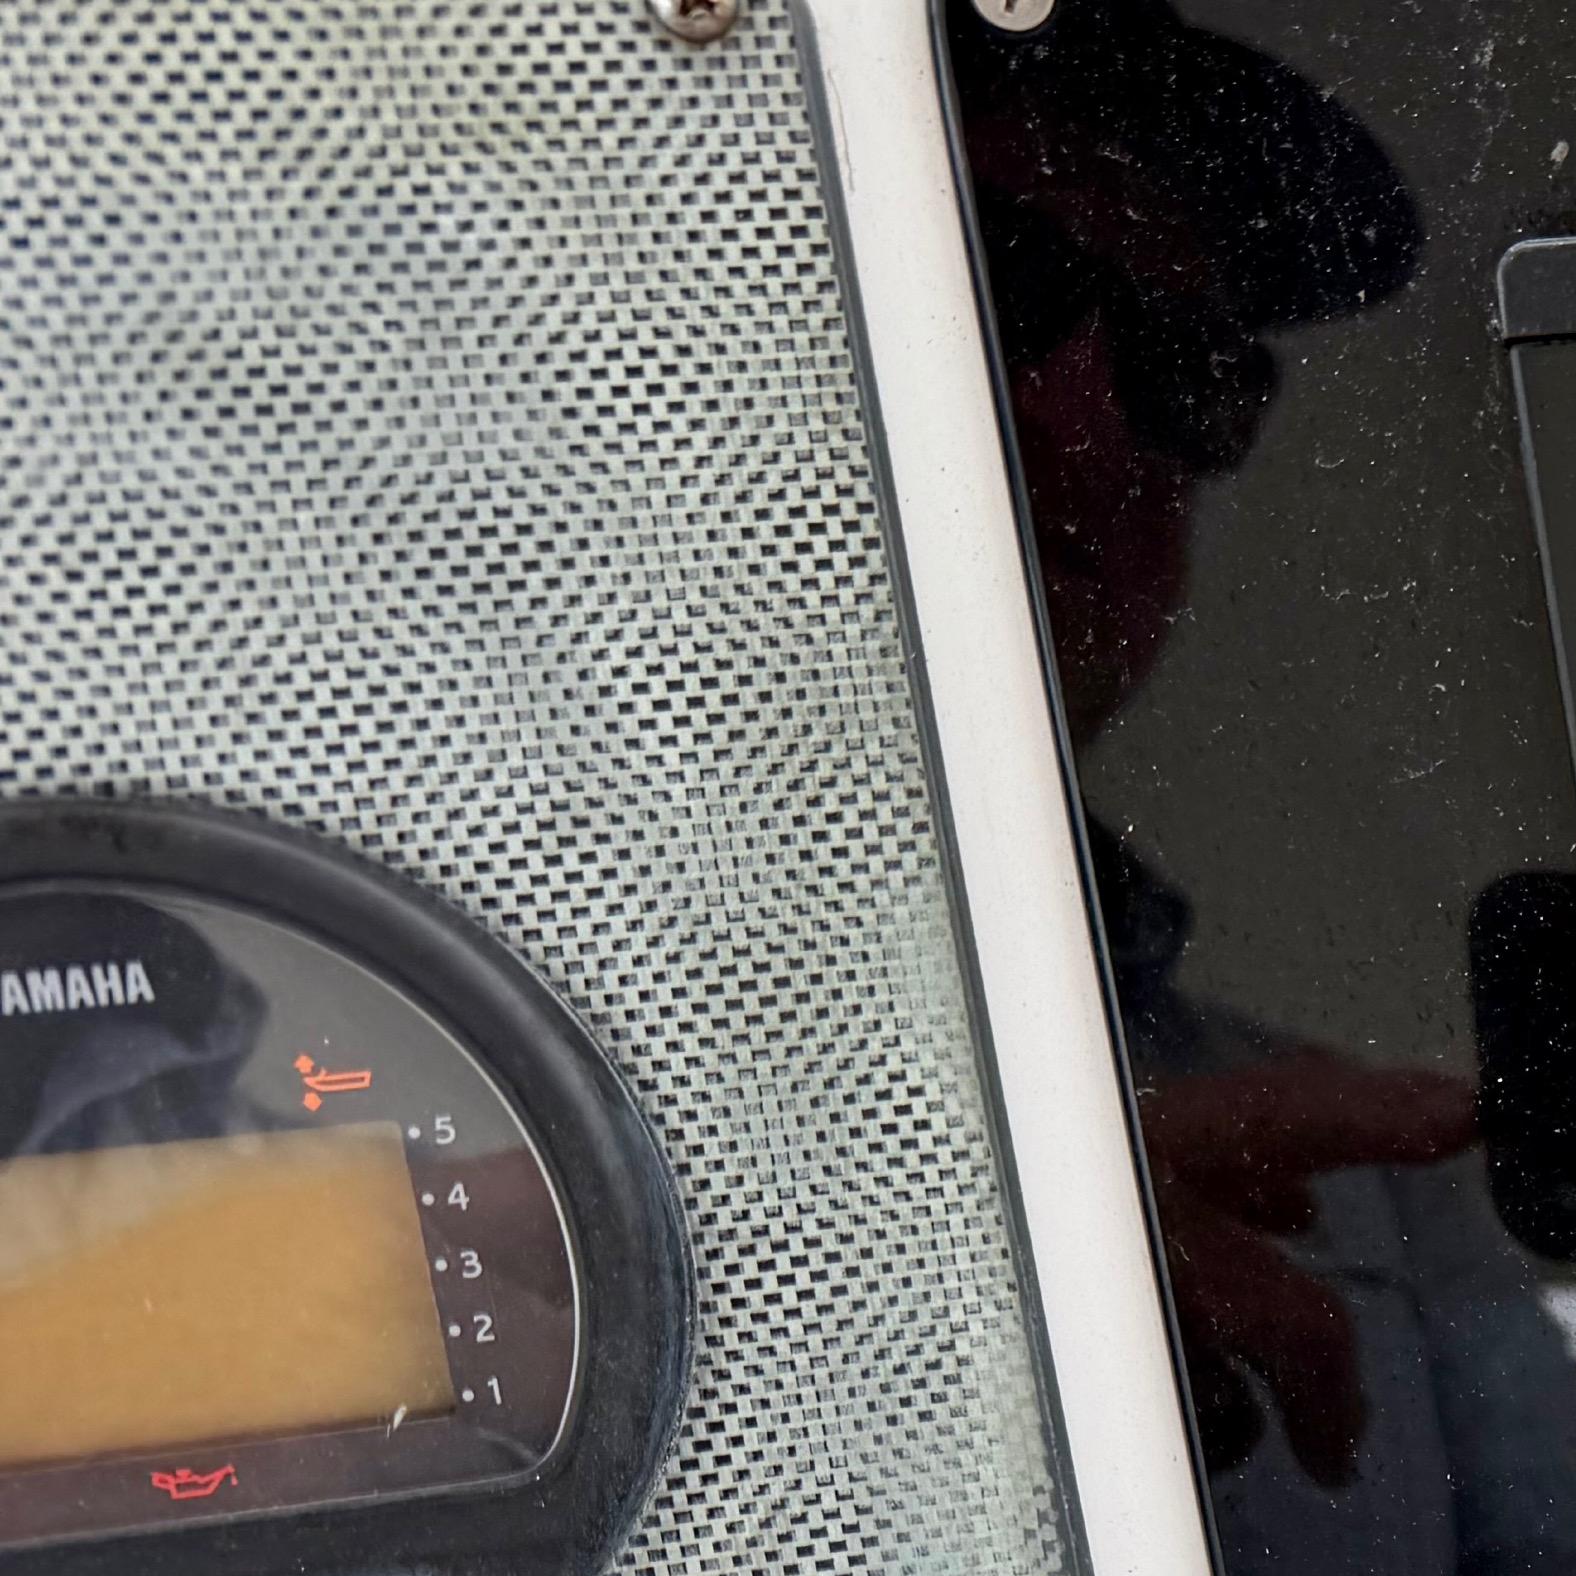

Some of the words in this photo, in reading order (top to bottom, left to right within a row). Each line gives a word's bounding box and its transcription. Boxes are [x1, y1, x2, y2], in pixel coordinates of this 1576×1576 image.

[0, 959, 156, 1016] AMAHA
[433, 1116, 456, 1145] 5
[447, 1184, 470, 1212] 4
[460, 1251, 483, 1279] 3
[473, 1314, 496, 1343] 2
[486, 1375, 502, 1405] 1
